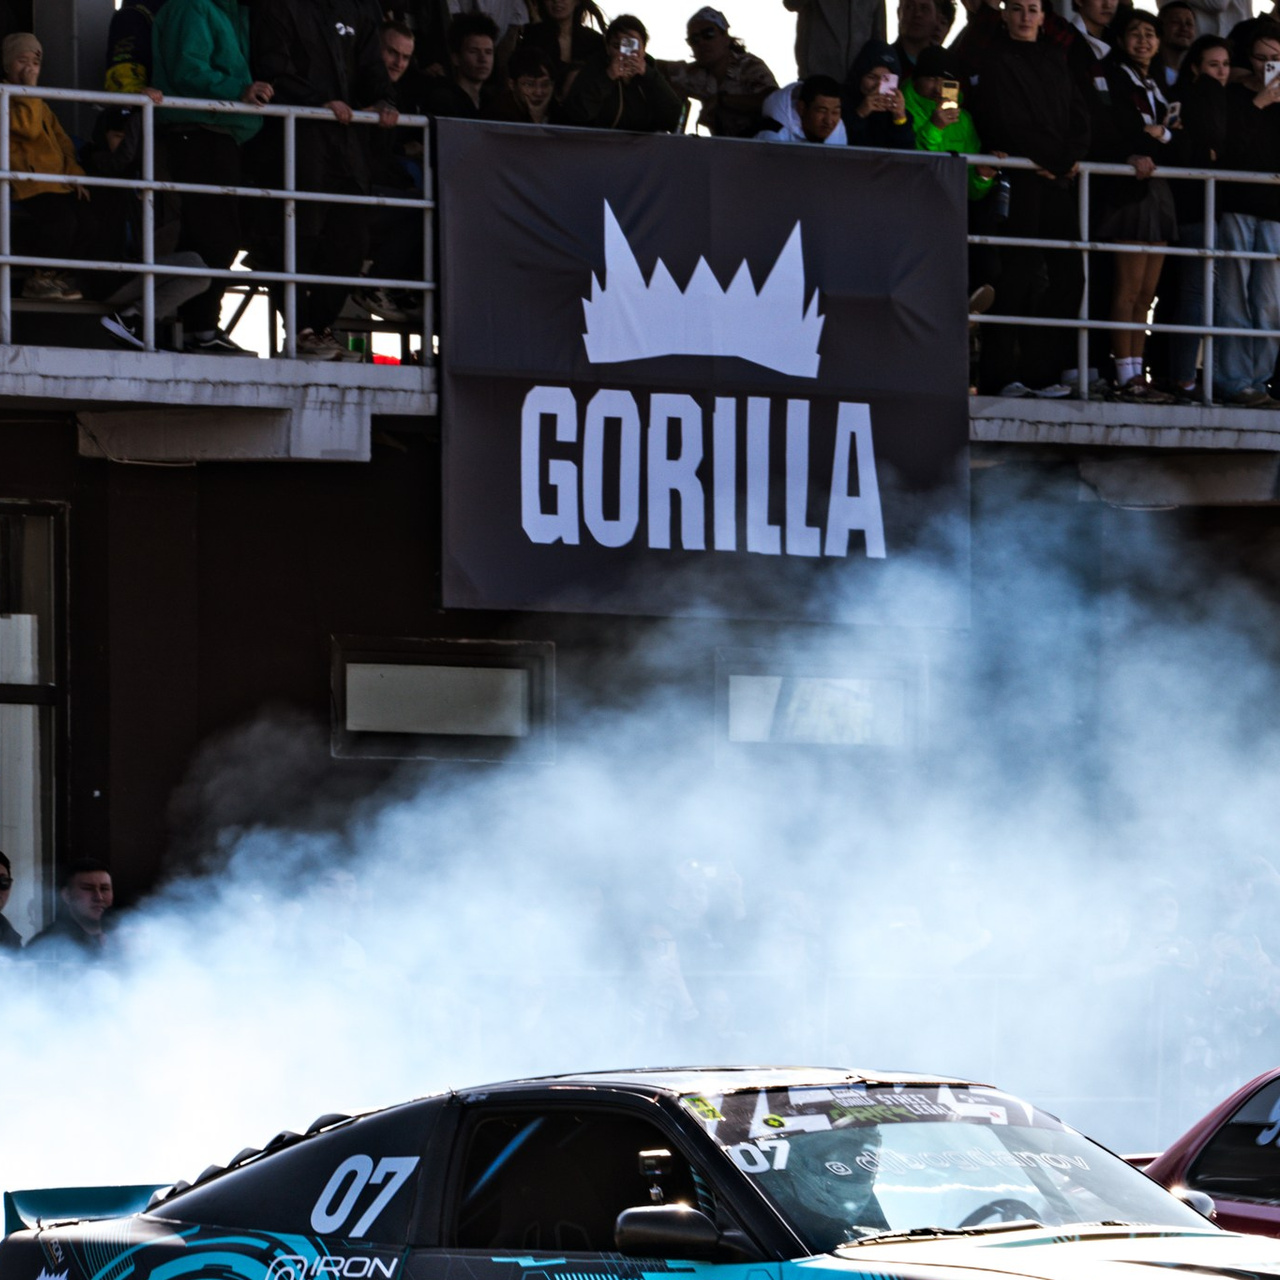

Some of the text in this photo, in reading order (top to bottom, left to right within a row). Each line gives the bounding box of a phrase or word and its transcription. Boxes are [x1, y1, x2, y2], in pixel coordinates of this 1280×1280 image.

[521, 385, 887, 559] GORILLA
[875, 1094, 933, 1105] STREET
[904, 1104, 957, 1115] LEGAL
[727, 1139, 791, 1174] 07
[310, 1154, 420, 1238] 07
[309, 1255, 398, 1278] IRON
